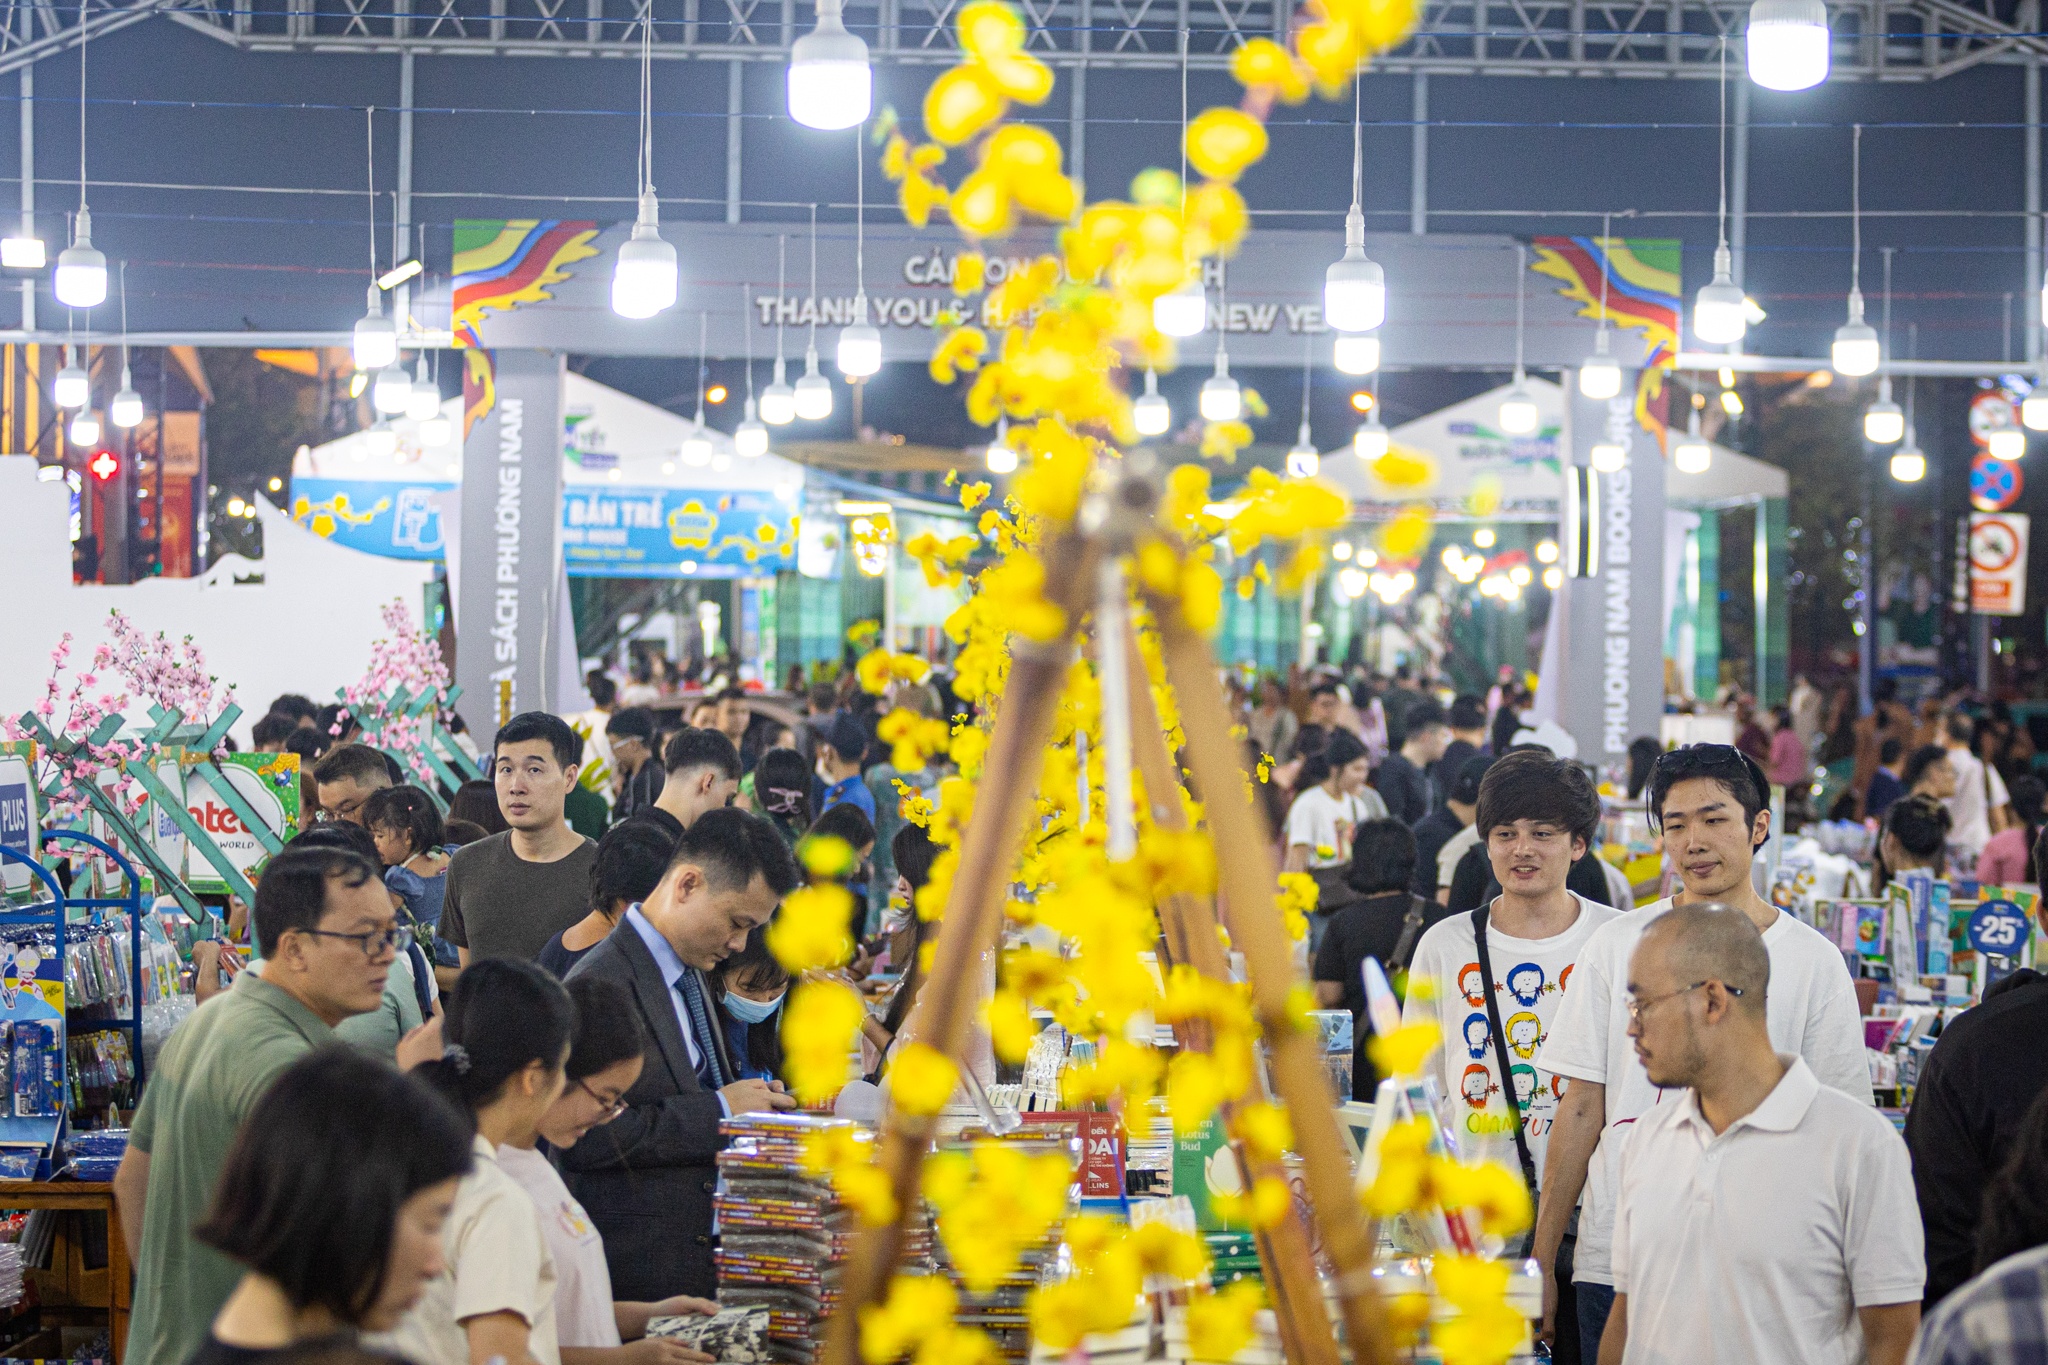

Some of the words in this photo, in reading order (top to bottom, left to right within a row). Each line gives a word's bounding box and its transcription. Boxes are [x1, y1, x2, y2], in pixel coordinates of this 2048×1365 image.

[873, 298, 938, 326] YOU
[1207, 302, 1280, 332] NEW
[500, 398, 524, 463] NAM
[491, 589, 519, 662] SÁCH
[1606, 569, 1632, 633] NAM
[1604, 637, 1631, 754] PHUONG
[2, 798, 26, 832] PLUS
[219, 841, 255, 850] WORLD
[1181, 1141, 1201, 1151] Bud
